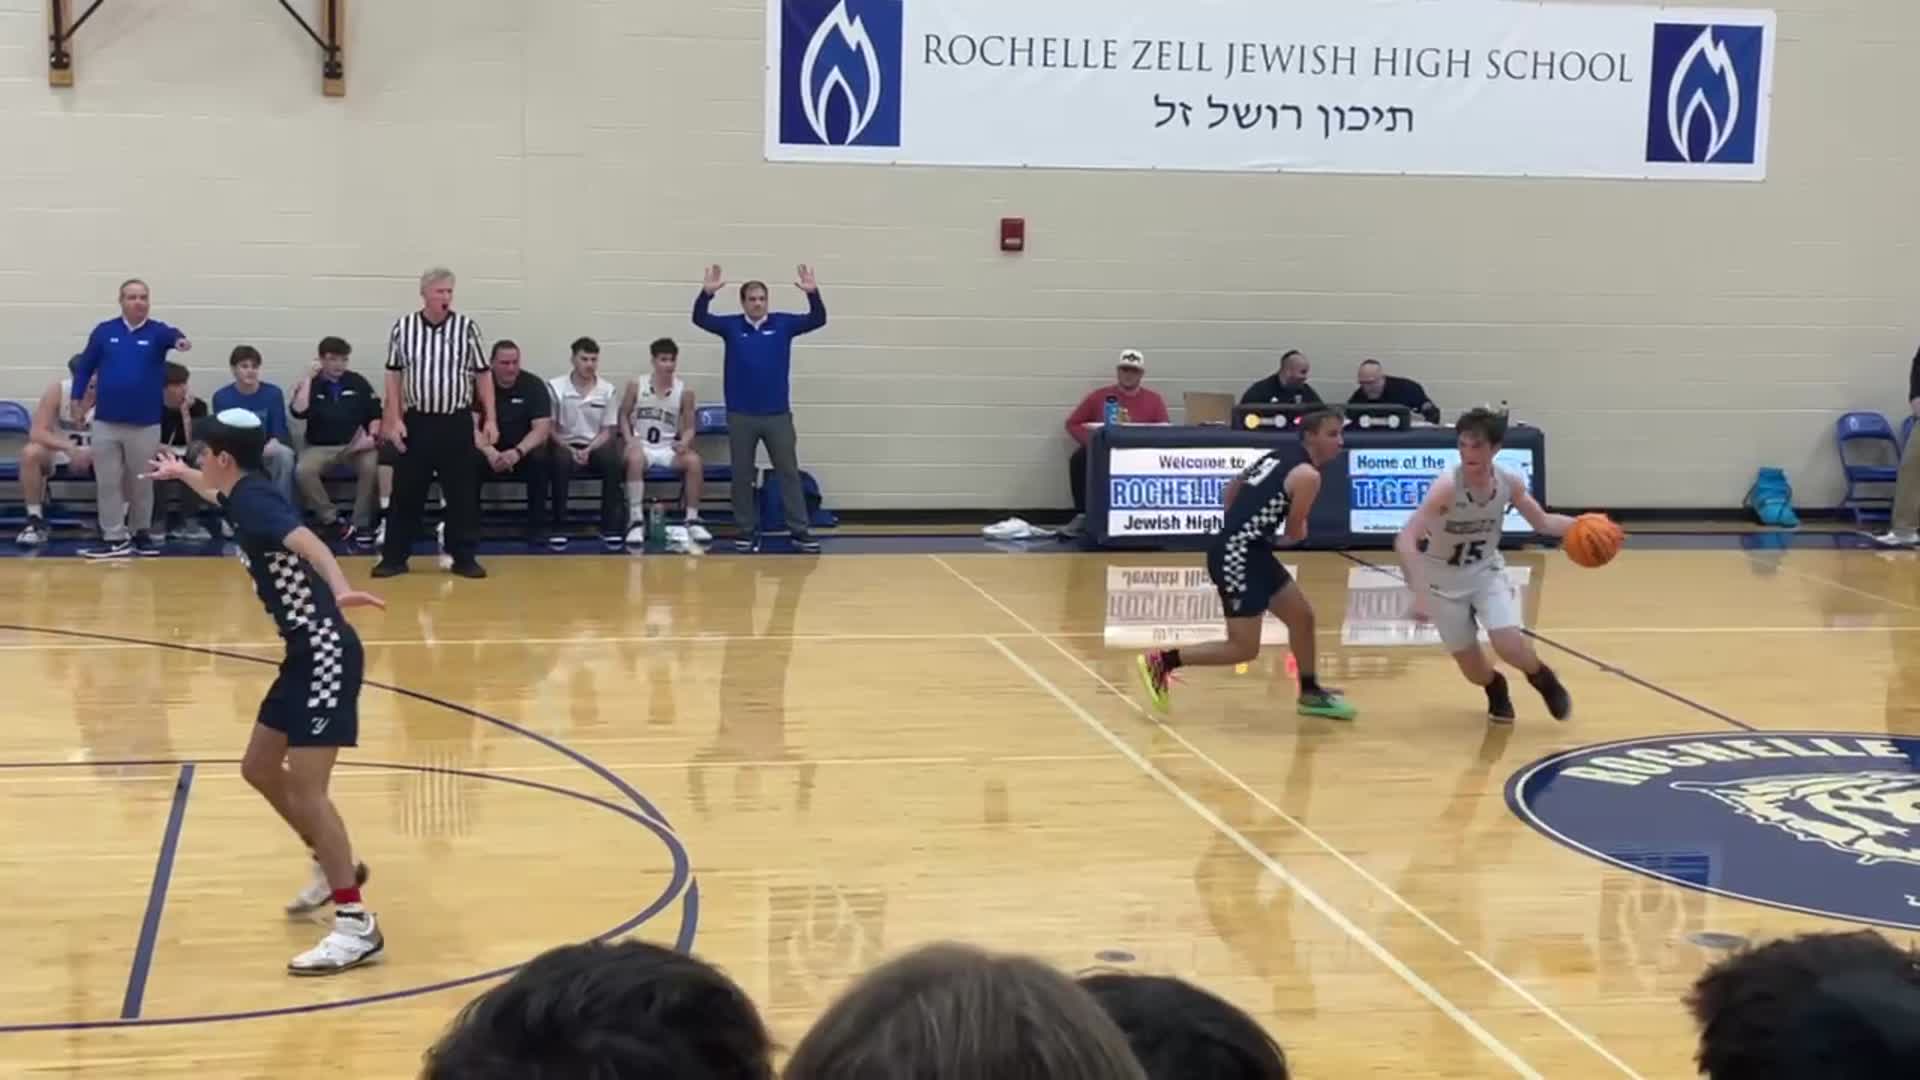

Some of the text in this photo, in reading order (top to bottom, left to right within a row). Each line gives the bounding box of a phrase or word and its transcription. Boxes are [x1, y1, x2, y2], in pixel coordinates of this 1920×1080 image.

[925, 35, 1632, 81] ROCHELLE ZELL JEWISH HIGH SCHOOL
[1154, 94, 1413, 139] תיכון רושל זל
[647, 426, 661, 444] 0
[1159, 455, 1246, 469] Welcome to
[1357, 455, 1399, 469] Home
[1422, 456, 1445, 469] the
[1353, 479, 1432, 507] TIGER
[1124, 514, 1223, 534] Jewish High
[1447, 540, 1487, 566] 15
[1559, 738, 1909, 785] ROCHELLE
